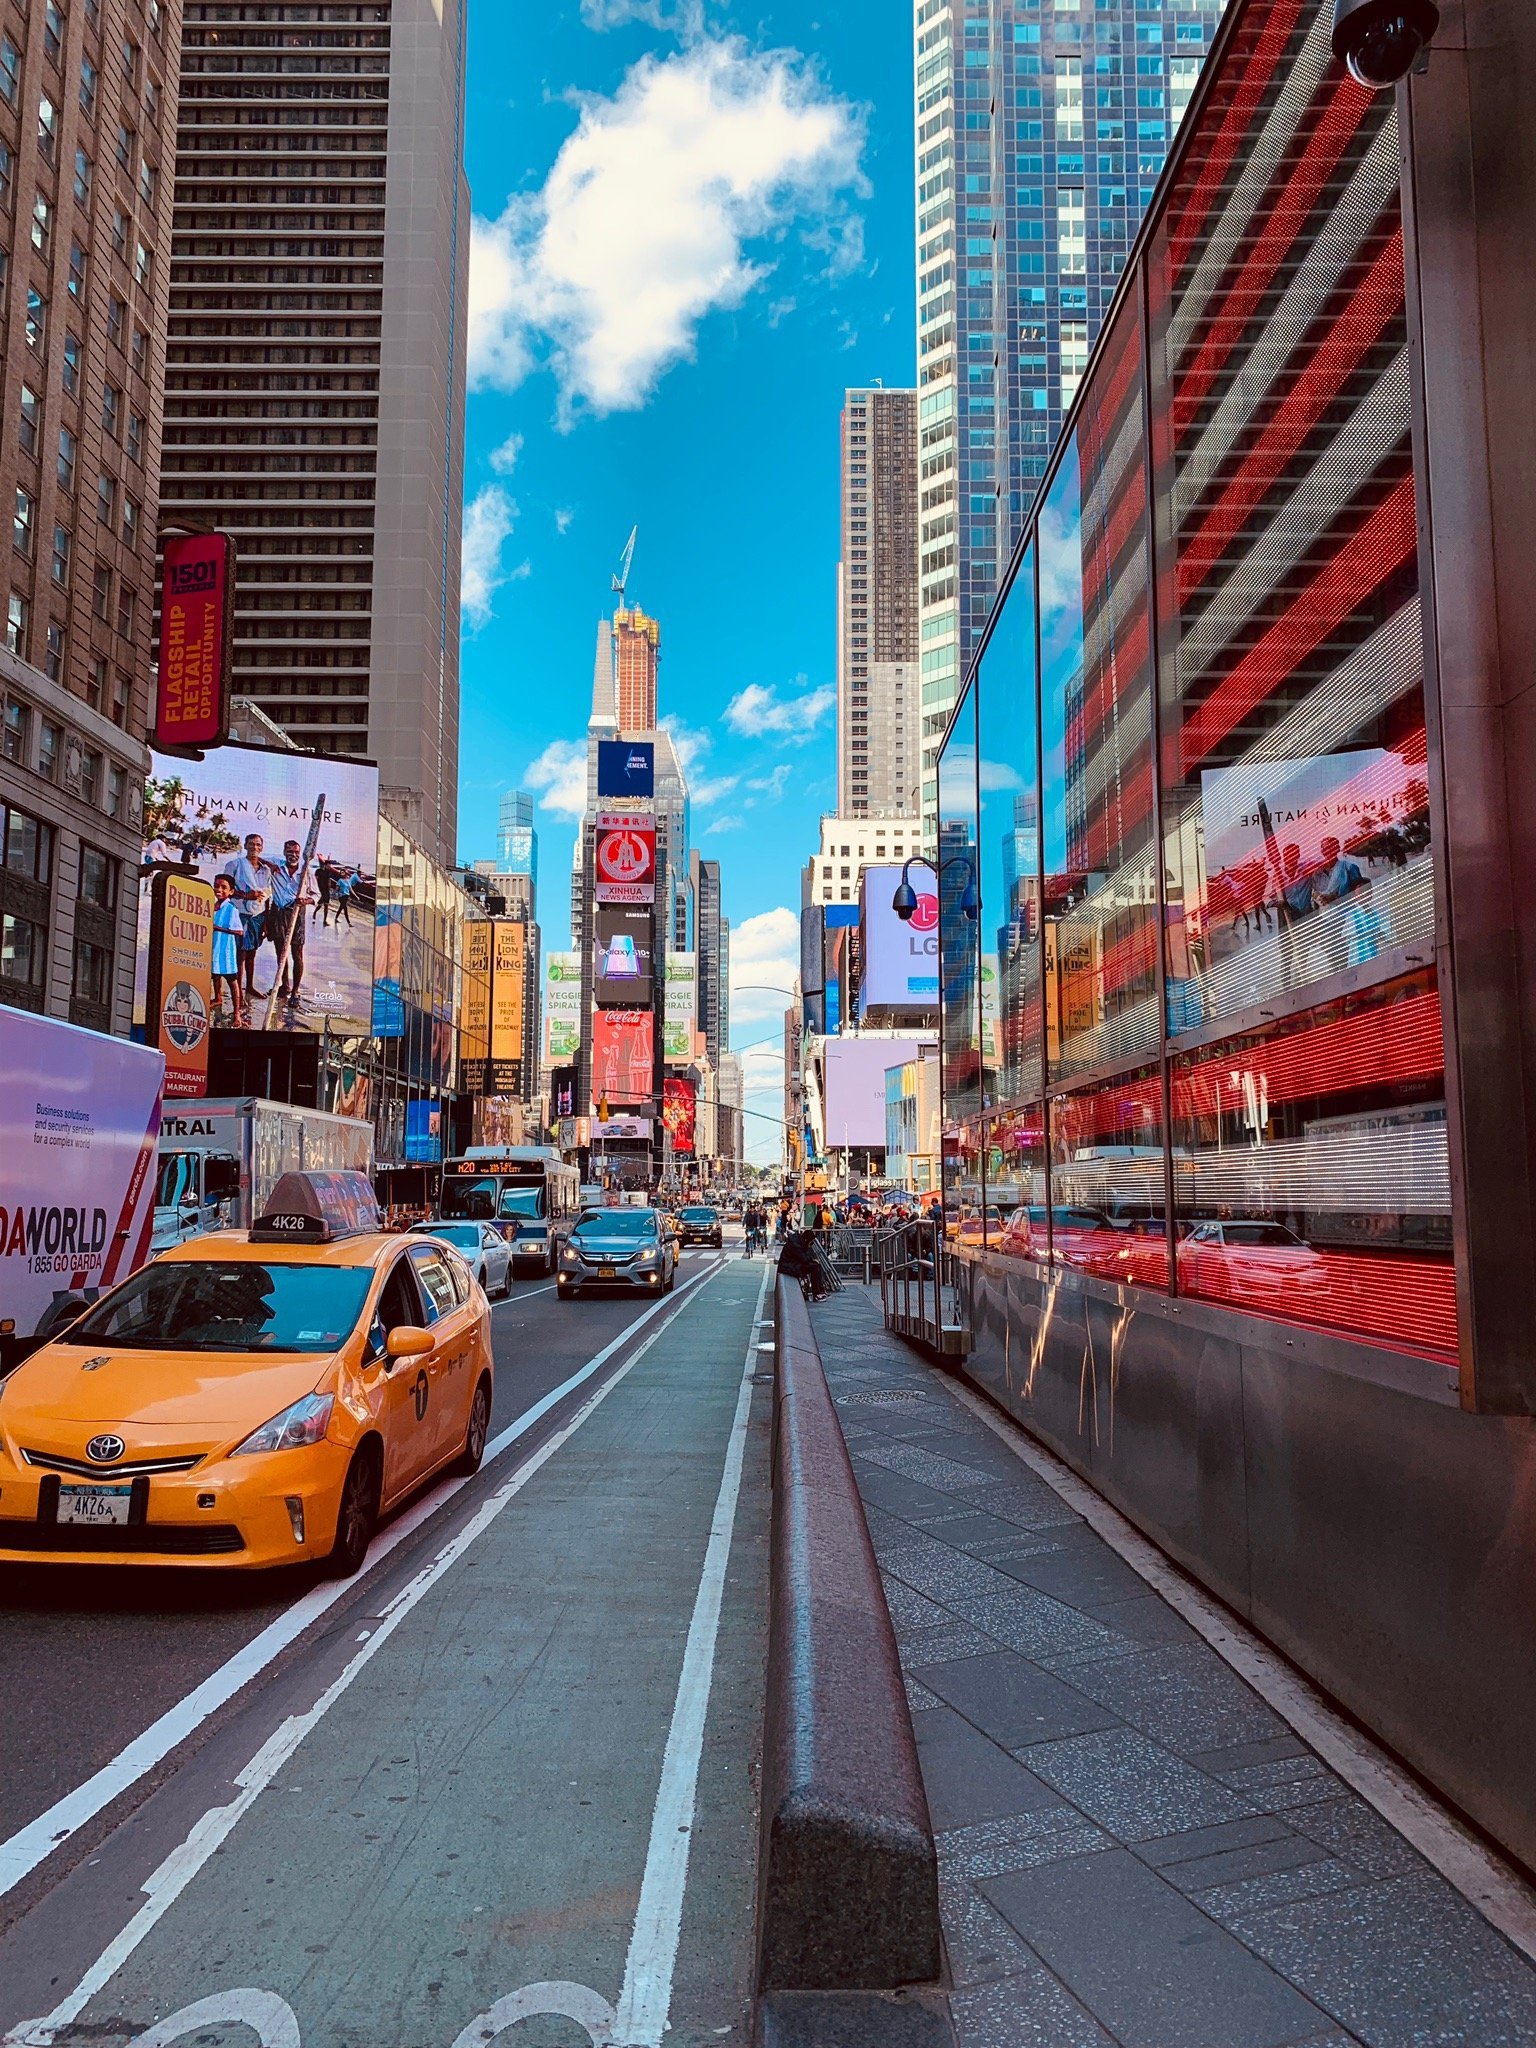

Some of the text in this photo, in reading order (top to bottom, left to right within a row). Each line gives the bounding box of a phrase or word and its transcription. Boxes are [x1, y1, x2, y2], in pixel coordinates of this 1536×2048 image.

[170, 560, 216, 585] 1501
[165, 605, 186, 722] FLAGSHIP
[200, 602, 216, 719] OPPORTUNITY
[183, 639, 201, 721] RETAIL
[184, 794, 342, 824] HUMAN by NATURE
[609, 887, 642, 895] XINHUA
[168, 885, 211, 918] BUBBA
[170, 914, 208, 944] GUMP
[172, 946, 204, 957] SHRIMP
[498, 944, 518, 955] LION
[599, 949, 630, 957] Galaxy
[909, 937, 938, 955] LG
[168, 955, 207, 970] COMPANY
[496, 956, 521, 970] KING
[314, 988, 342, 1001] kerala
[163, 1013, 186, 1026] BUBBA
[165, 1071, 206, 1083] ESTAURANT
[167, 1083, 197, 1093] MARKET
[36, 1103, 89, 1121] Business solutions
[35, 1119, 94, 1135] and security services
[34, 1132, 90, 1149] for a complex world
[458, 1162, 475, 1173] M20
[129, 1150, 148, 1205] garda.com
[272, 1216, 305, 1230] 4K26
[28, 1254, 101, 1273] 1 855 GO GARDA
